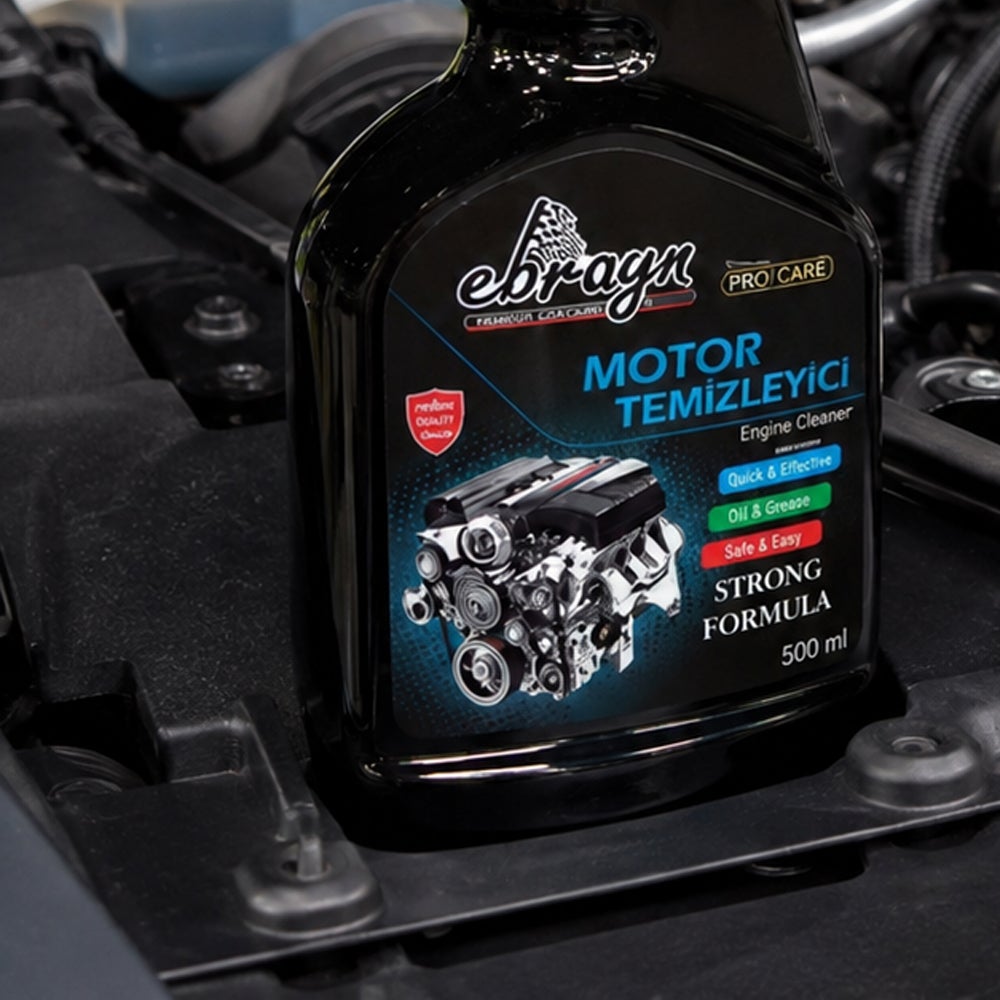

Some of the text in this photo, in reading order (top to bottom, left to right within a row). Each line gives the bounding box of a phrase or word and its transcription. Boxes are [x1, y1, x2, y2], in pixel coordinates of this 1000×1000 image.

[728, 260, 826, 292] PRO CARE
[583, 331, 762, 392] MOTOR
[740, 406, 854, 442] Engine Cleaner
[728, 467, 764, 487] Quick
[767, 465, 777, 480] &
[728, 495, 811, 523] Oil & Grease
[724, 532, 803, 560] Safe & Easy
[714, 556, 823, 603] STRONG
[702, 589, 832, 641] FORMULA
[781, 628, 848, 667] 500 ml
